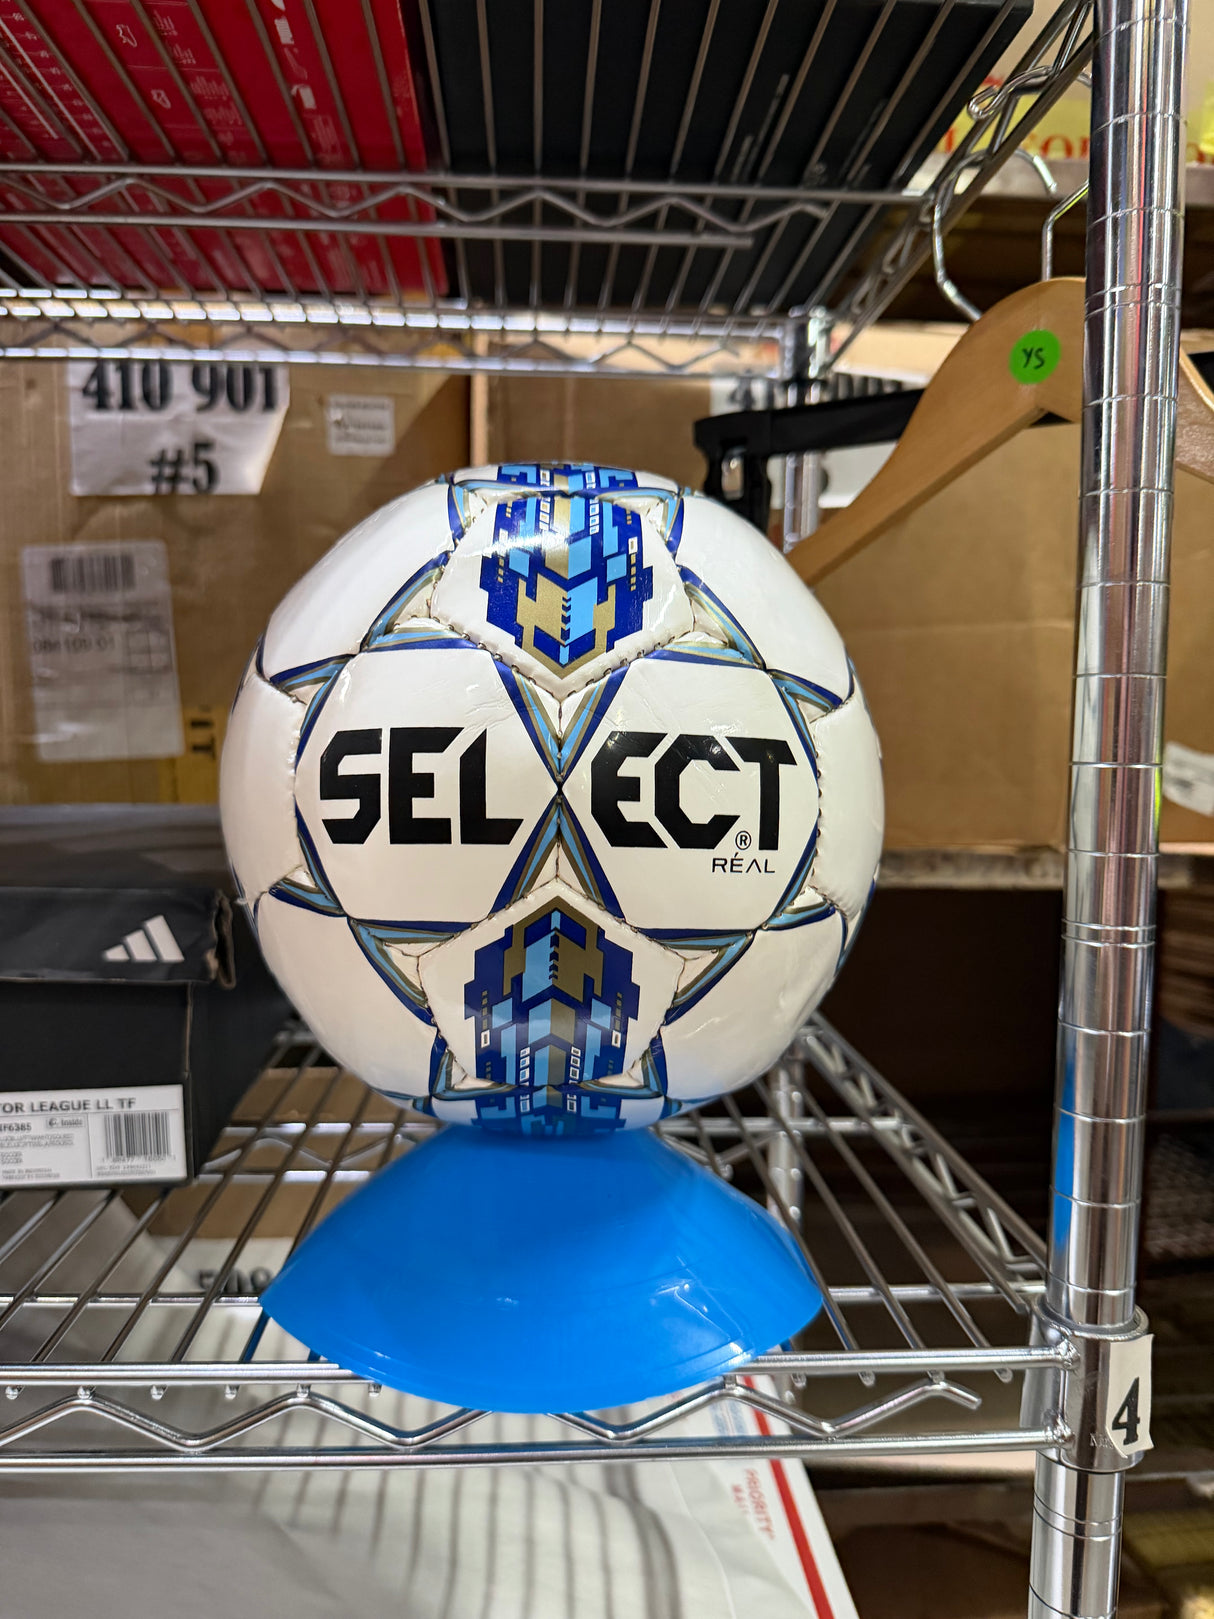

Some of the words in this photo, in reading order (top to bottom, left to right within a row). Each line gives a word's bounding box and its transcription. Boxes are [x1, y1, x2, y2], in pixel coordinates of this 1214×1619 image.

[82, 360, 174, 412] 410
[191, 364, 279, 413] 901
[149, 441, 220, 495] #5
[0, 1102, 25, 1114] OR
[31, 1099, 91, 1113] LEAGUE
[96, 1099, 114, 1110] LL
[117, 1097, 137, 1110] TF
[1111, 1376, 1141, 1447] 4
